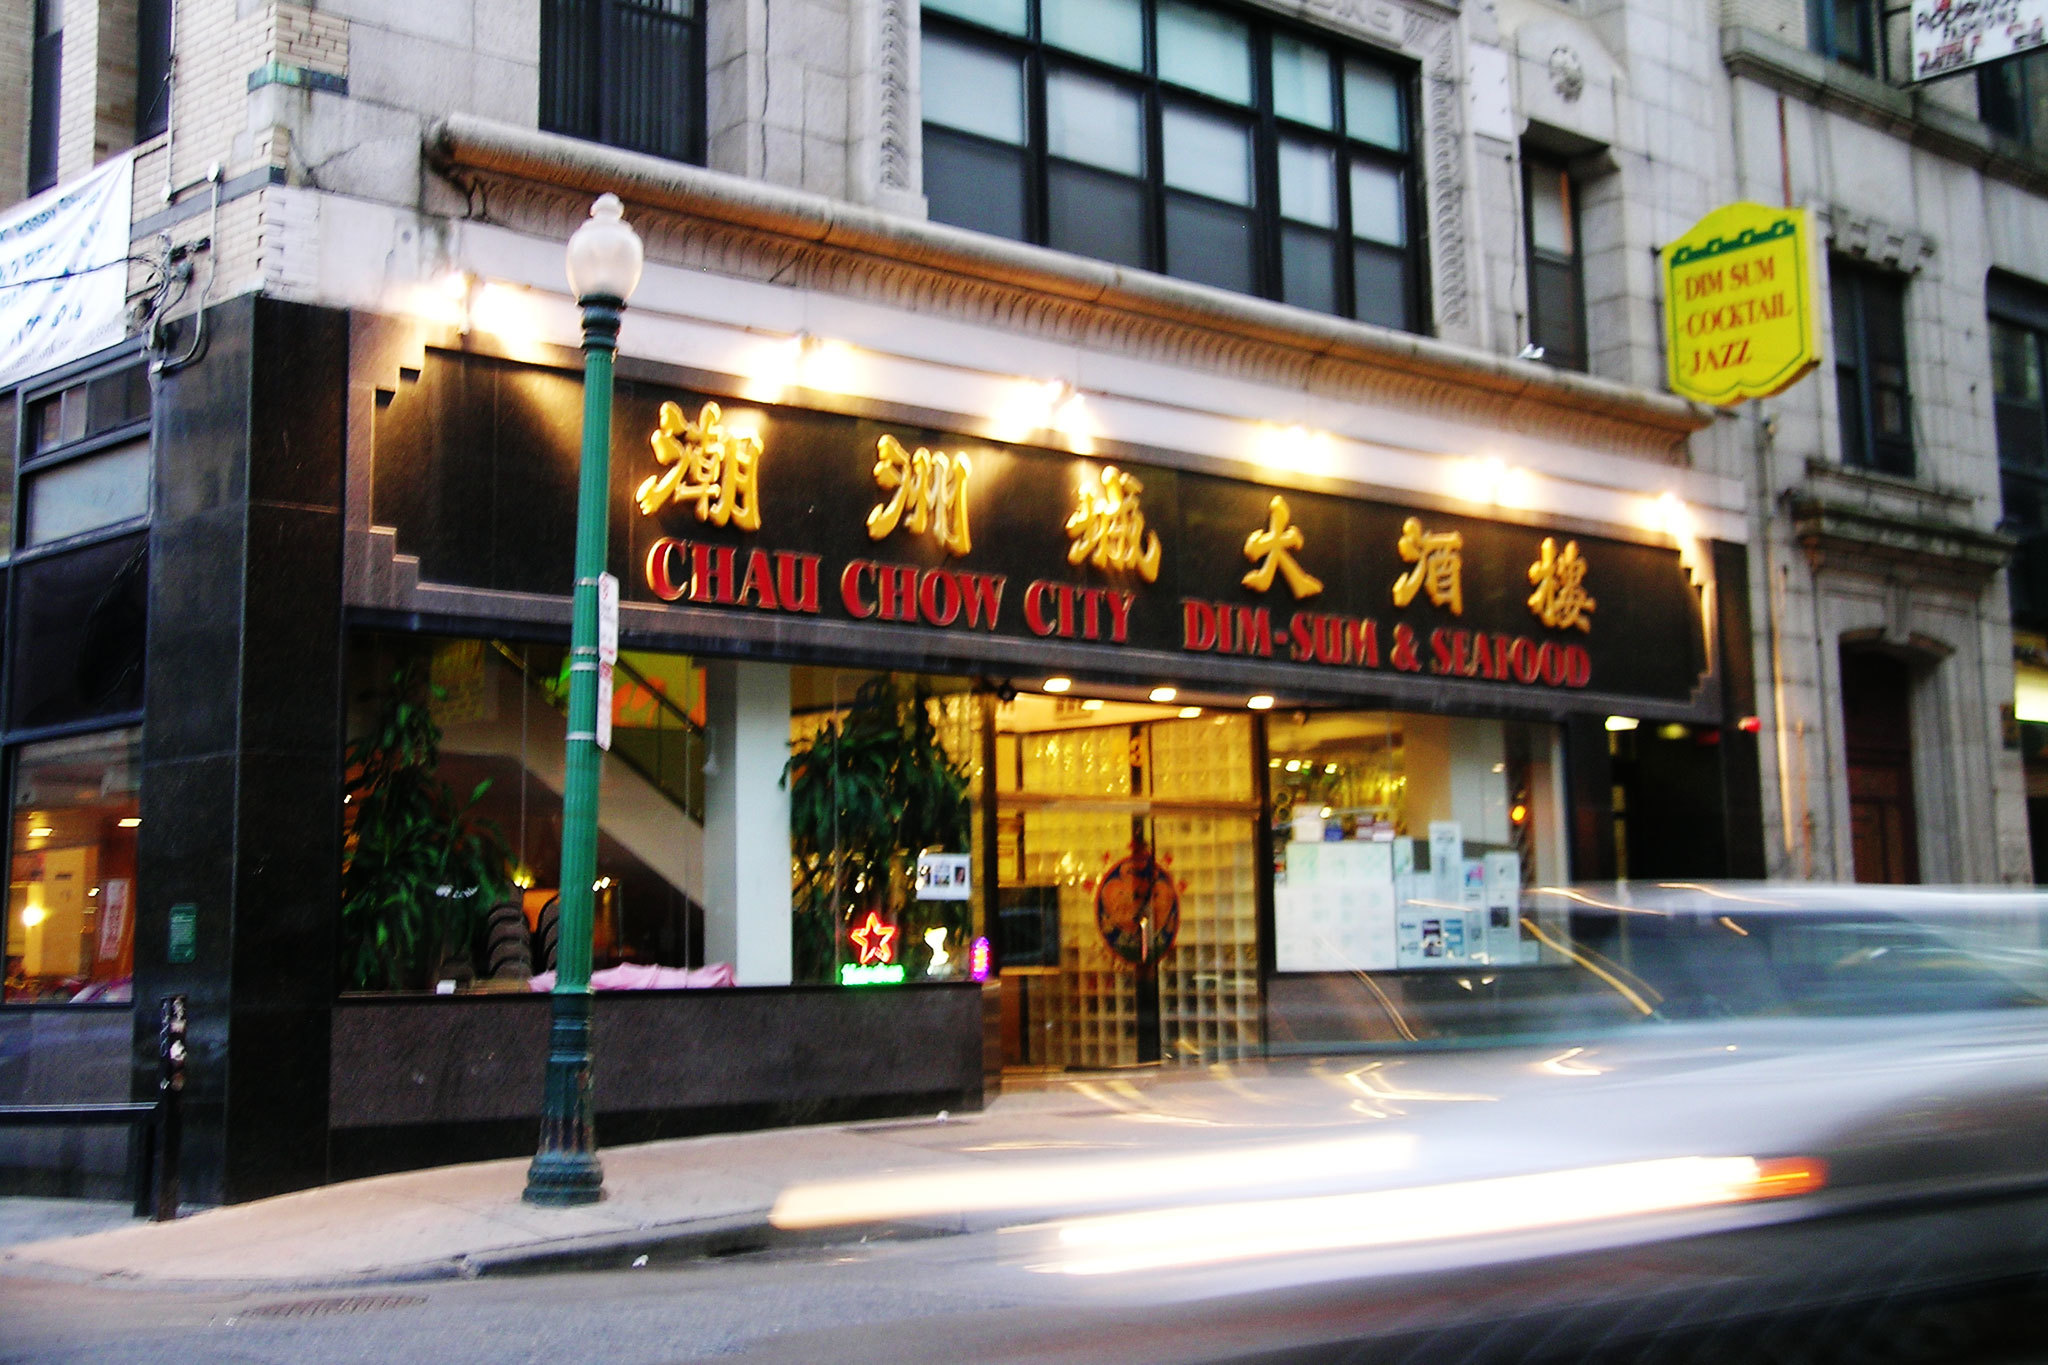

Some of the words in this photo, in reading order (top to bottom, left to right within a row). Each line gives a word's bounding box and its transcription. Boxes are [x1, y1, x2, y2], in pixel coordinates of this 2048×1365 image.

[1685, 268, 1724, 301] DIM
[1729, 256, 1776, 290] SUM
[1687, 293, 1792, 338] COCKTAIL
[1689, 340, 1751, 376] JAZZ
[645, 536, 821, 613] CHAU
[840, 559, 1006, 631] CHOW
[1024, 579, 1136, 644] CITY
[1391, 623, 1421, 672] &
[1430, 627, 1591, 688] SEAFOOD
